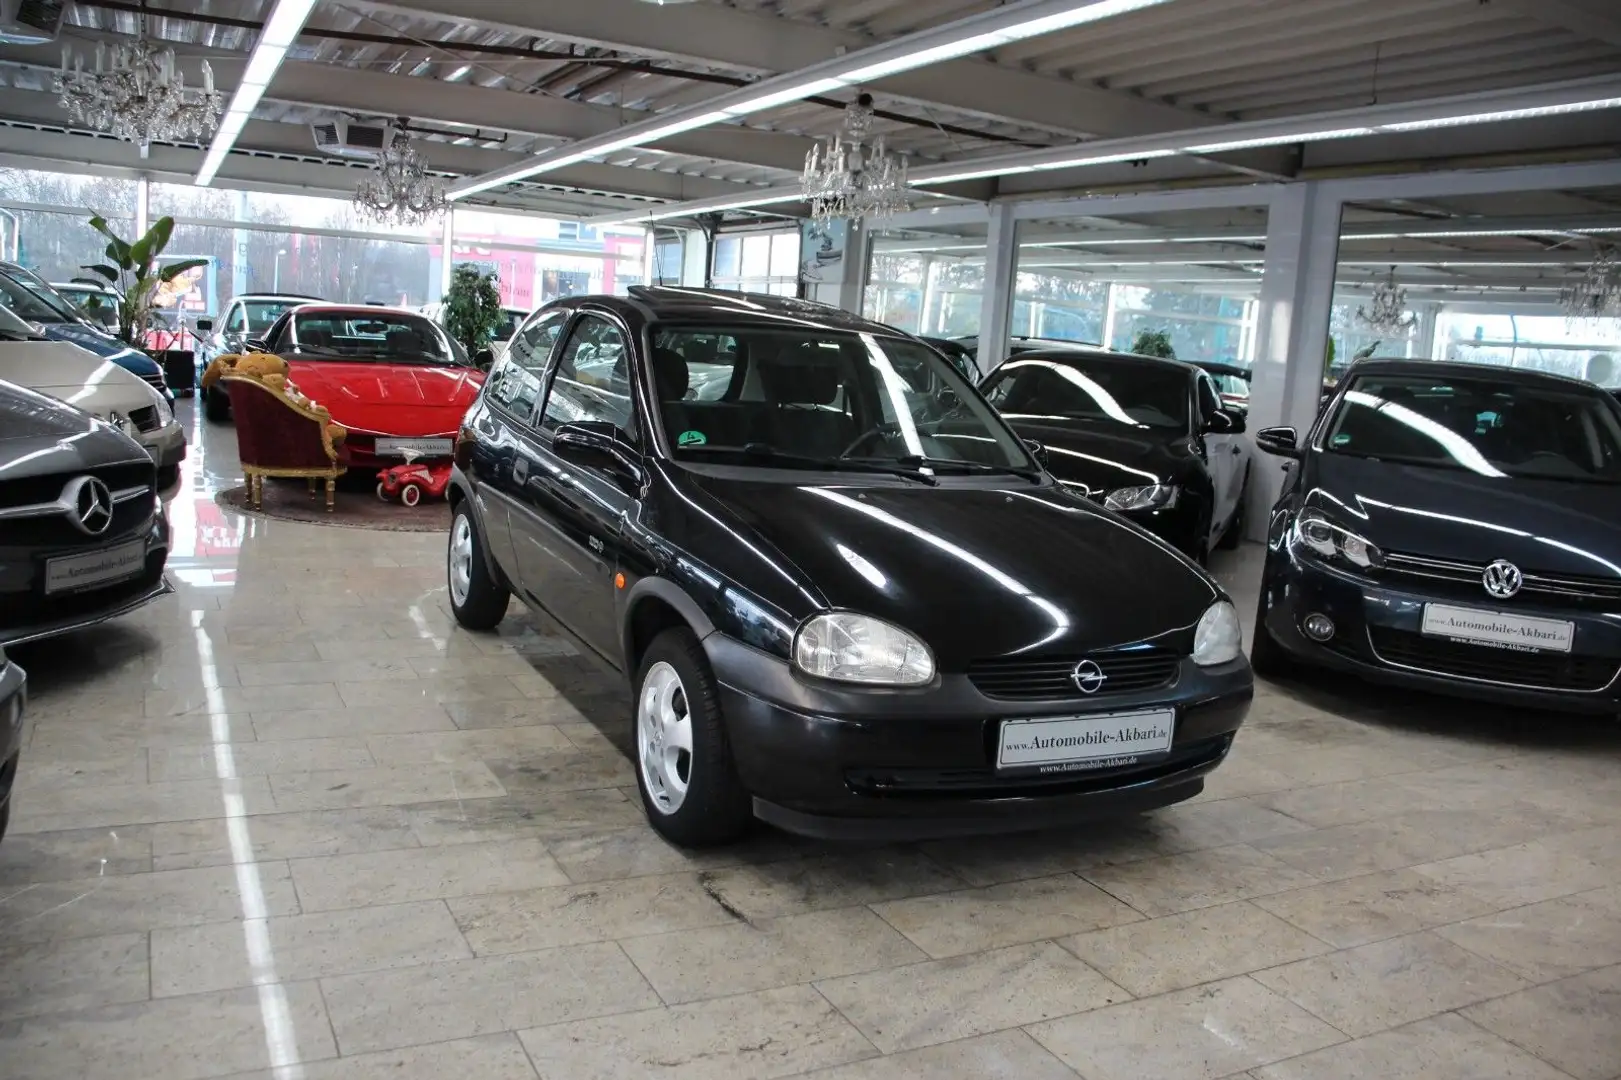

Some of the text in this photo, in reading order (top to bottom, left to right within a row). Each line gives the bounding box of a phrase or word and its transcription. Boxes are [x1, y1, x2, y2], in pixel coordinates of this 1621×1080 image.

[1428, 617, 1567, 641] www.Automobile-Akbari.de
[1005, 725, 1167, 751] www.Automobile-Akbari.de
[1040, 755, 1138, 773] www.Automobile-Akbari.de
